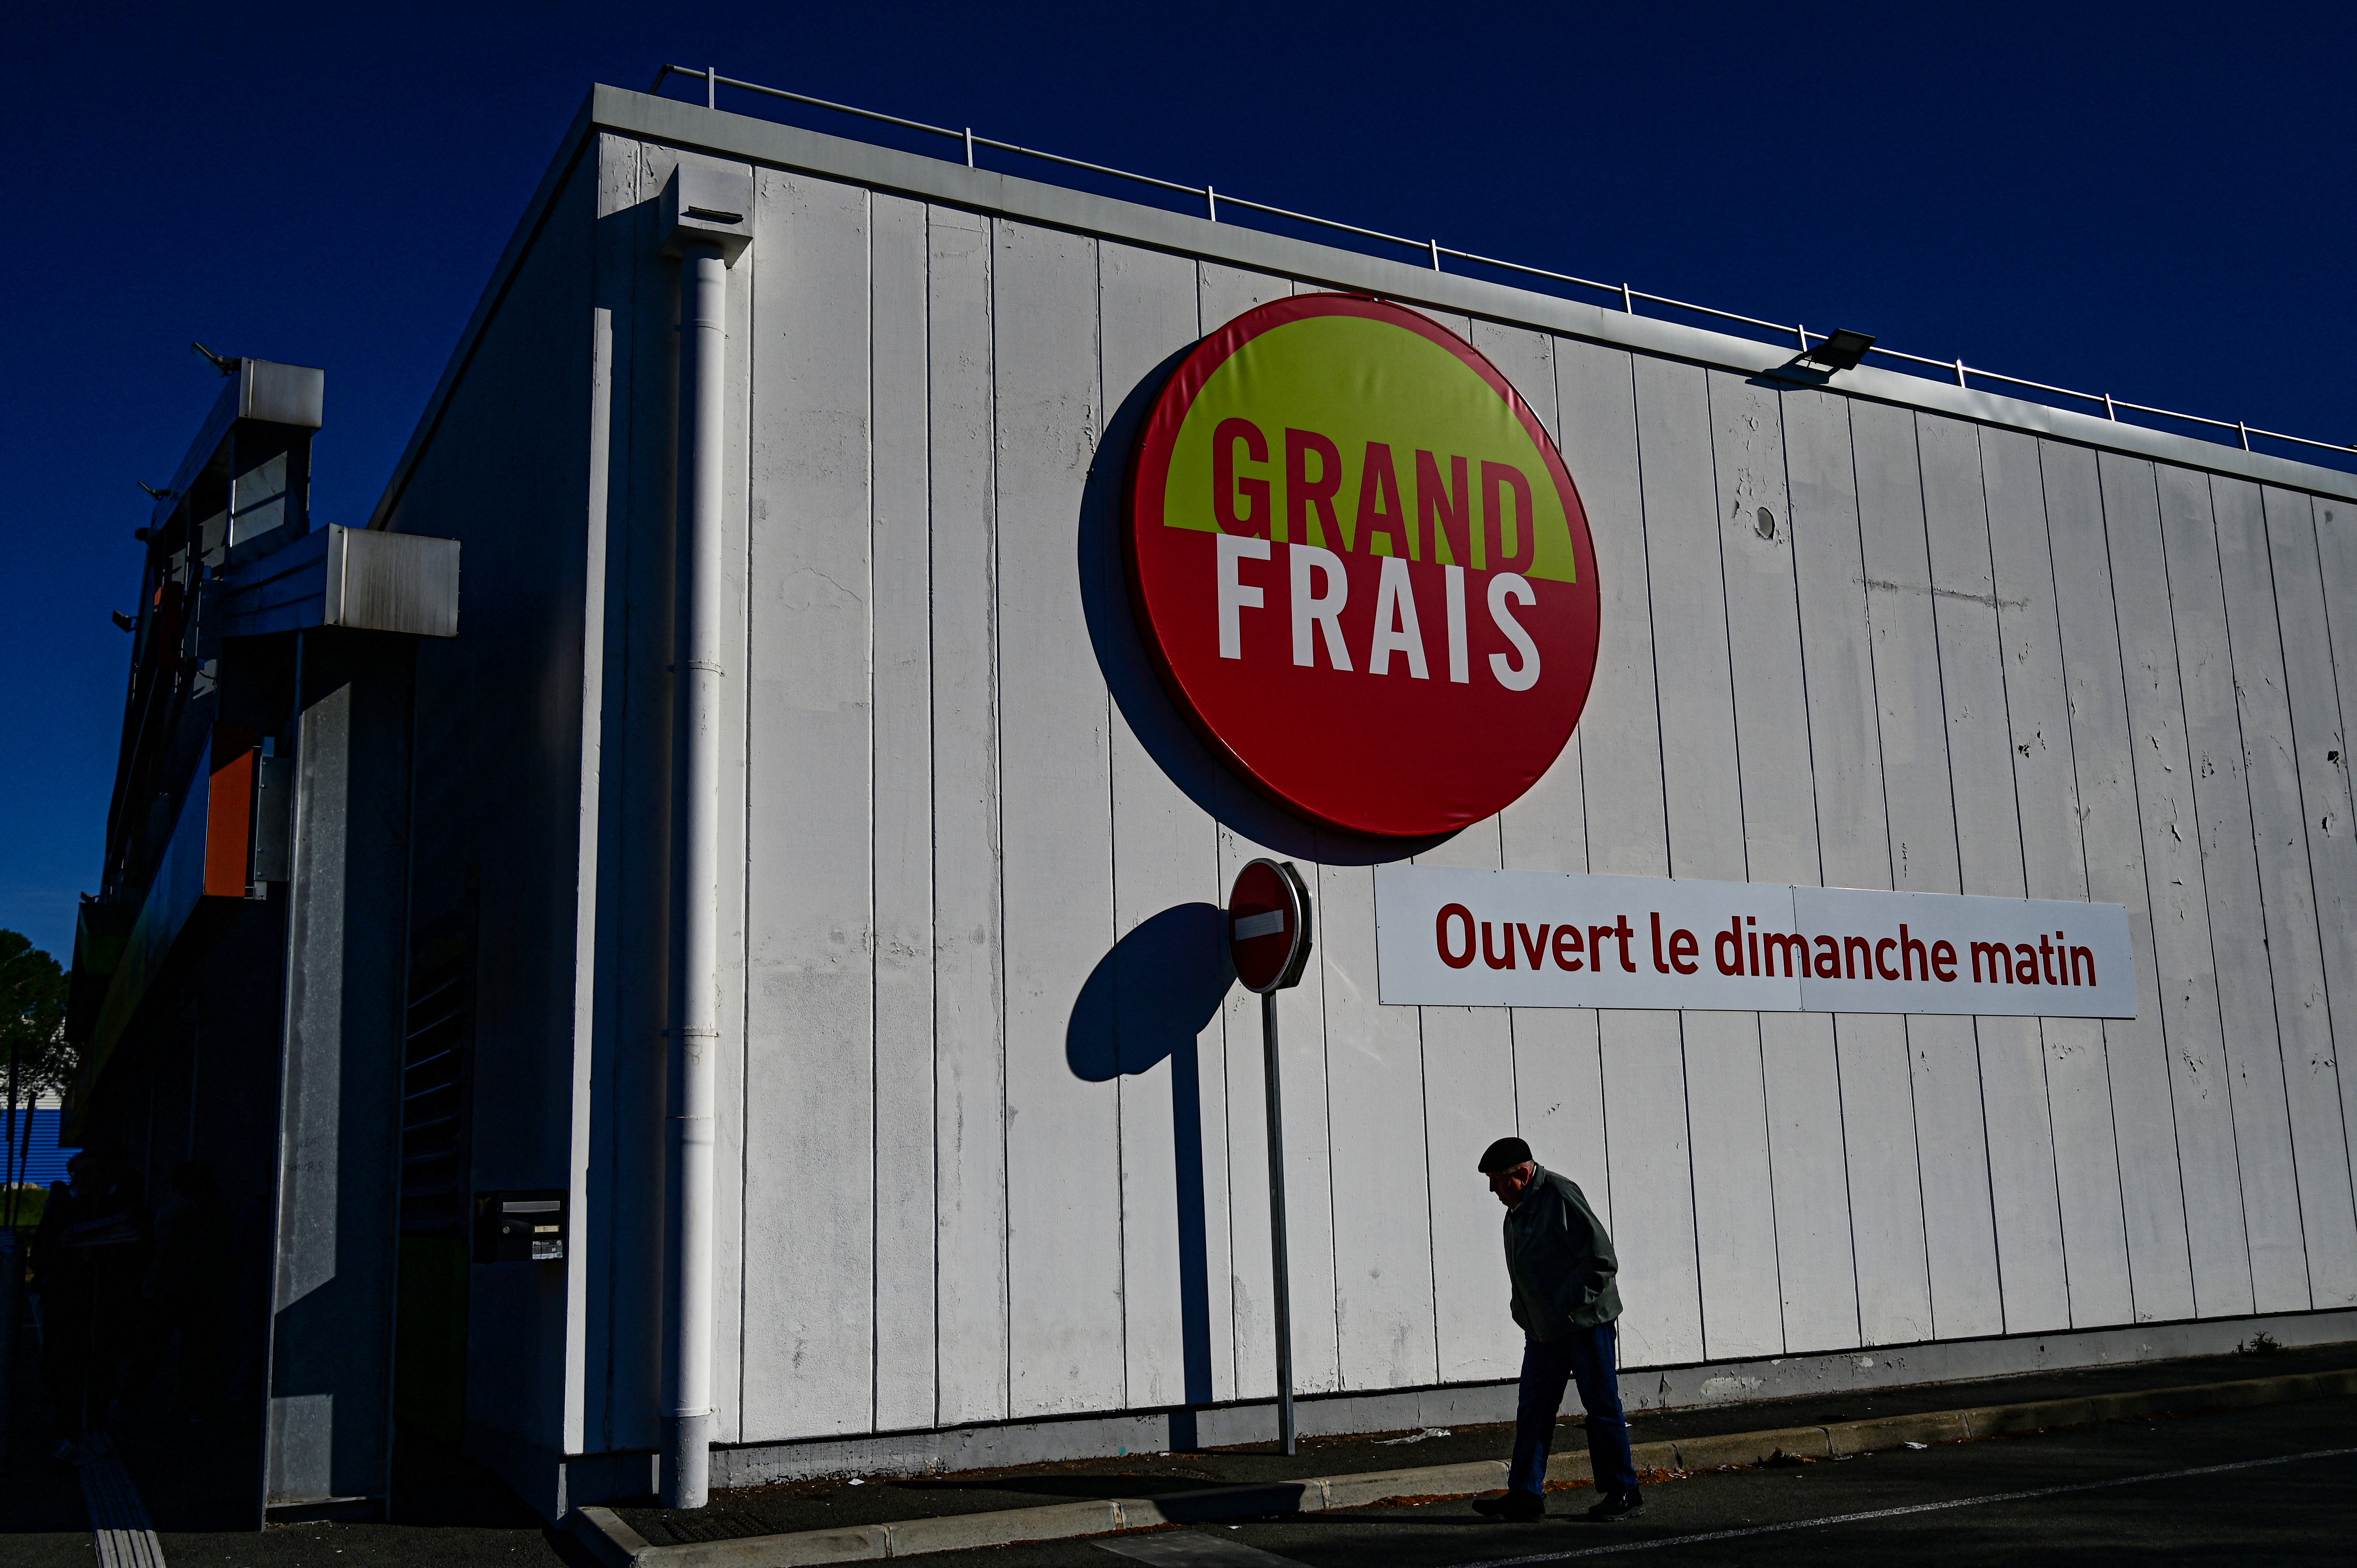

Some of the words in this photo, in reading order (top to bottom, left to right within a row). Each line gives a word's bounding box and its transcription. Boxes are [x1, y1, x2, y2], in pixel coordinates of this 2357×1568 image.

[1212, 417, 1535, 577] GRAND
[1216, 533, 1541, 691] FRAIS
[1436, 903, 1635, 972] Ouvert
[1652, 913, 1699, 974] le
[1716, 916, 1956, 981] dimanche
[1971, 931, 2095, 986] matin
